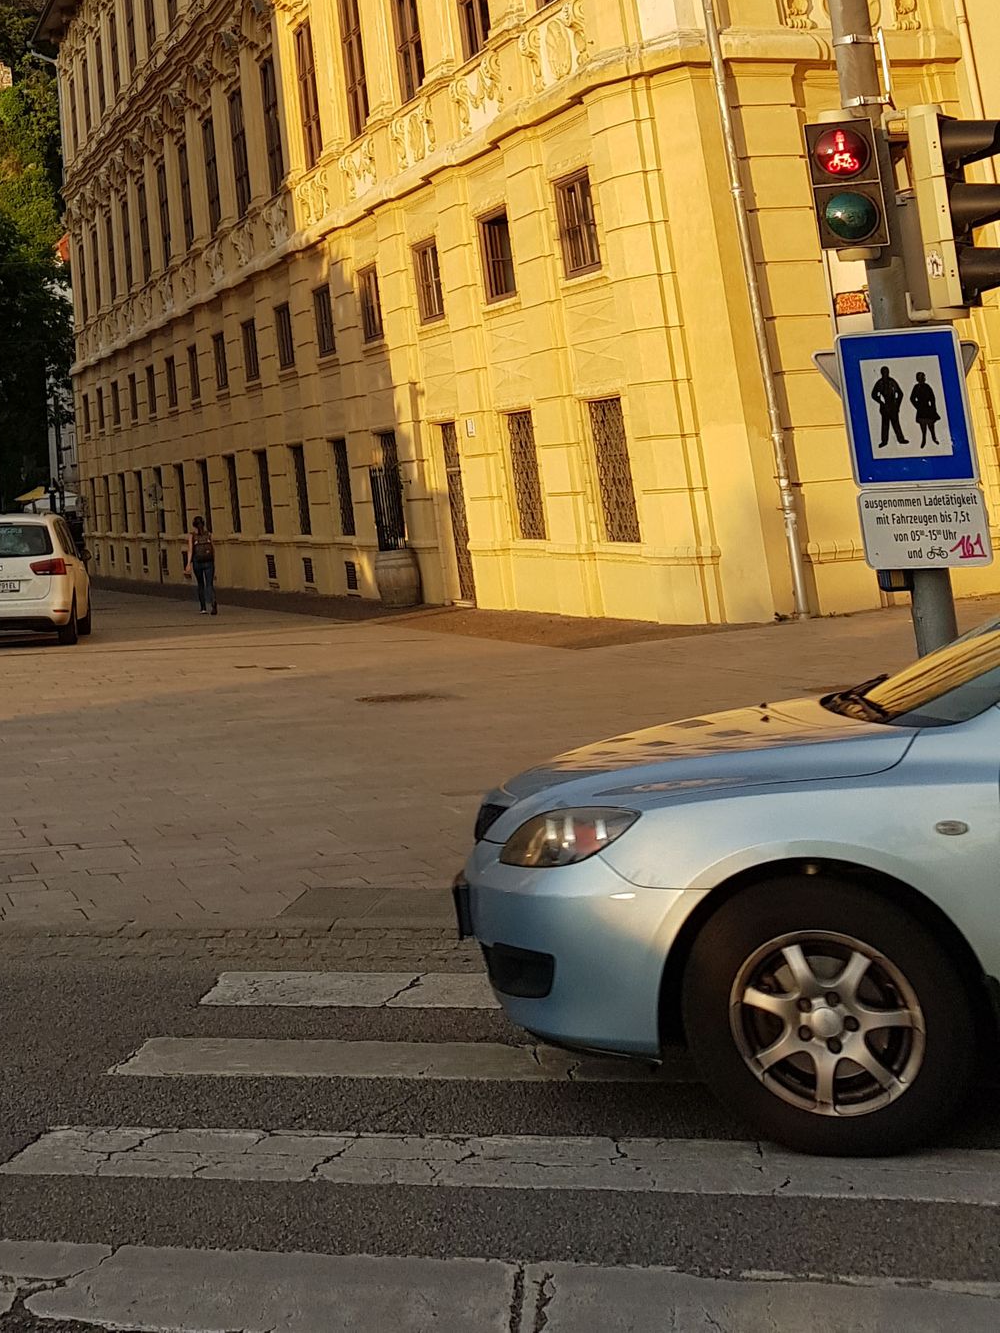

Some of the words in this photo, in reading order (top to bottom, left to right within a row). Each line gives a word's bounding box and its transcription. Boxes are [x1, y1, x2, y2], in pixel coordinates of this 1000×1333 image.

[864, 496, 922, 511] ausgenommen
[923, 493, 978, 508] Ladetätigkeit
[876, 514, 890, 525] mit
[891, 512, 938, 526] Fahrzeugen
[939, 511, 952, 523] bis
[893, 532, 909, 542] von
[942, 529, 957, 540] Uhr
[907, 547, 923, 559] und
